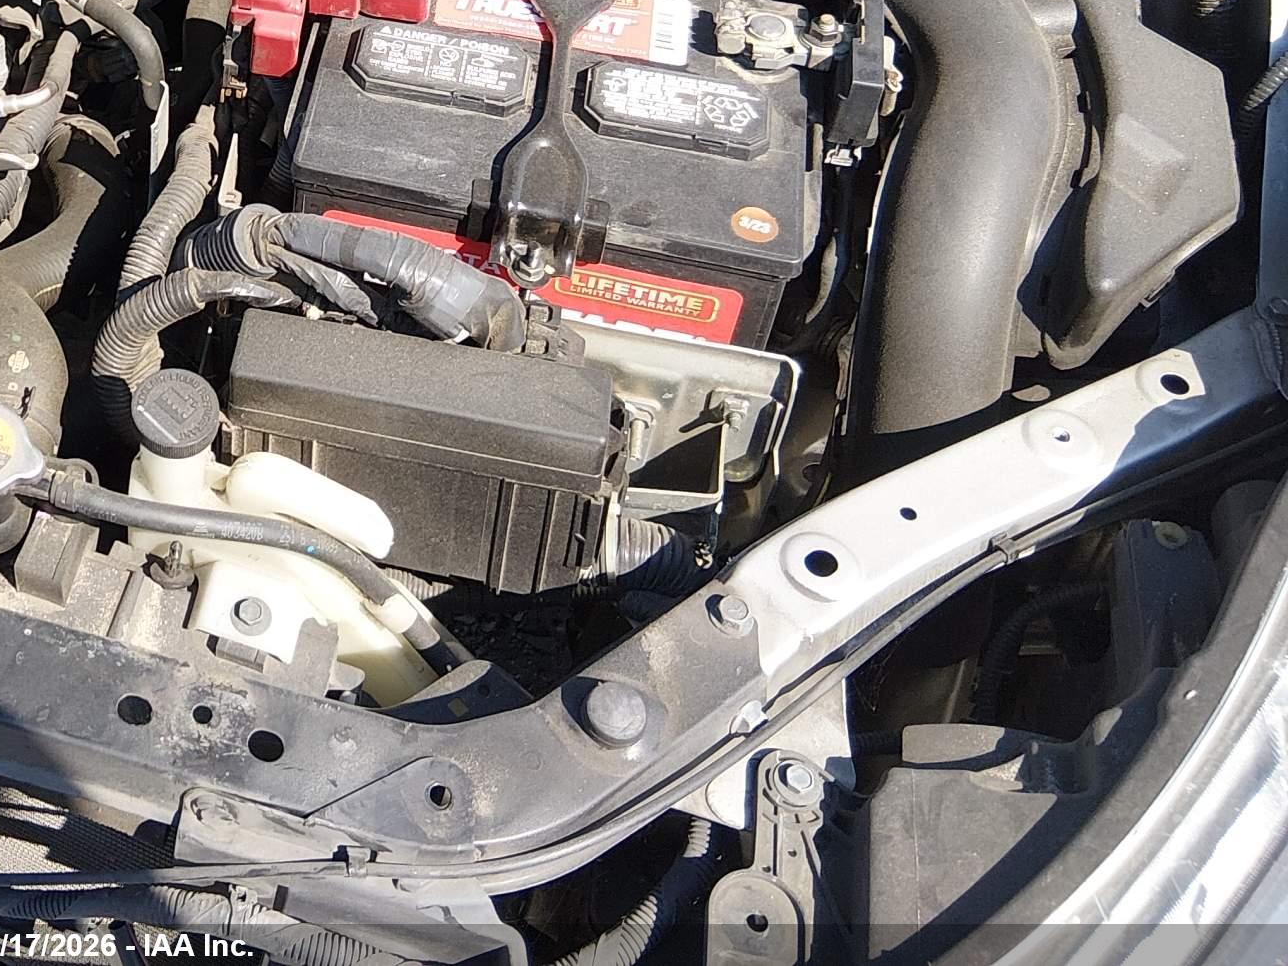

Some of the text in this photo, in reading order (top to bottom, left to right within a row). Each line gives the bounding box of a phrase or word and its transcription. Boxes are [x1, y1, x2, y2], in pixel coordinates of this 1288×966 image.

[394, 27, 447, 45] DANGER
[460, 39, 510, 55] POISON
[739, 216, 771, 234] 3/23
[569, 285, 700, 317] LIMITED WARRANTY
[571, 273, 705, 311] LIFETIME
